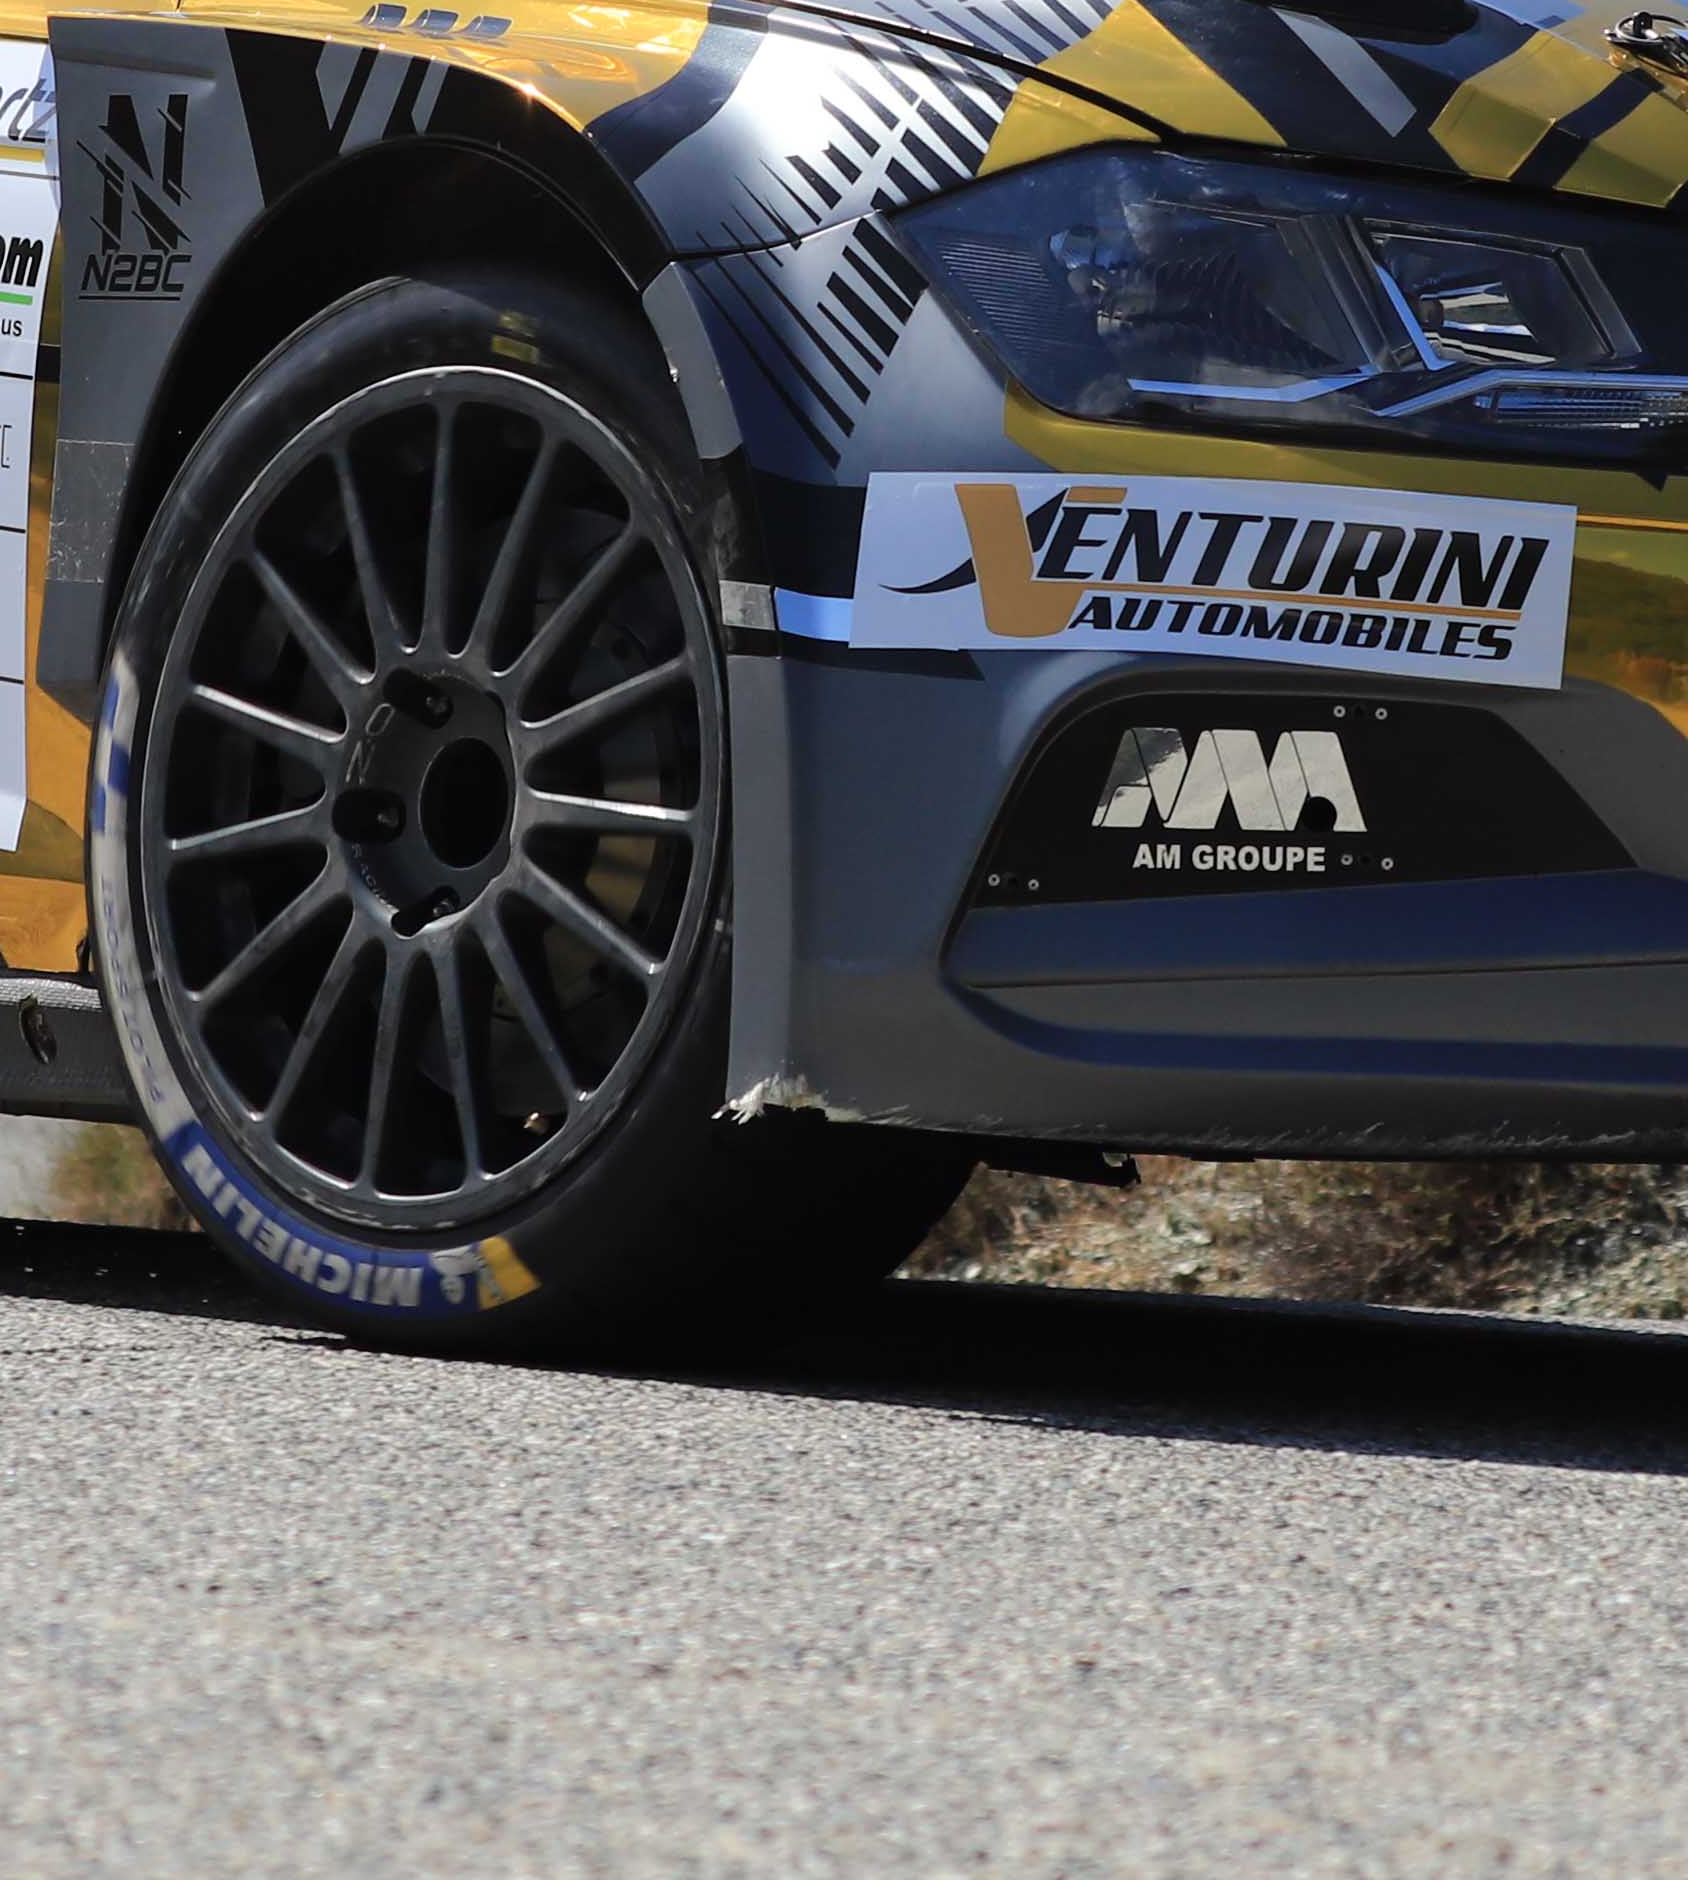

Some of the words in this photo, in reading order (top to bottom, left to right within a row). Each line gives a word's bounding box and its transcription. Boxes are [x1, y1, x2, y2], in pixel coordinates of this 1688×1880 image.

[81, 254, 192, 293] N2BC
[955, 484, 1550, 638] VENTURINI
[1063, 596, 1517, 661] AUTOMOBILES
[1132, 843, 1181, 870] AM
[1191, 844, 1326, 872] GROUPE
[181, 1143, 425, 1307] MICHELIN
